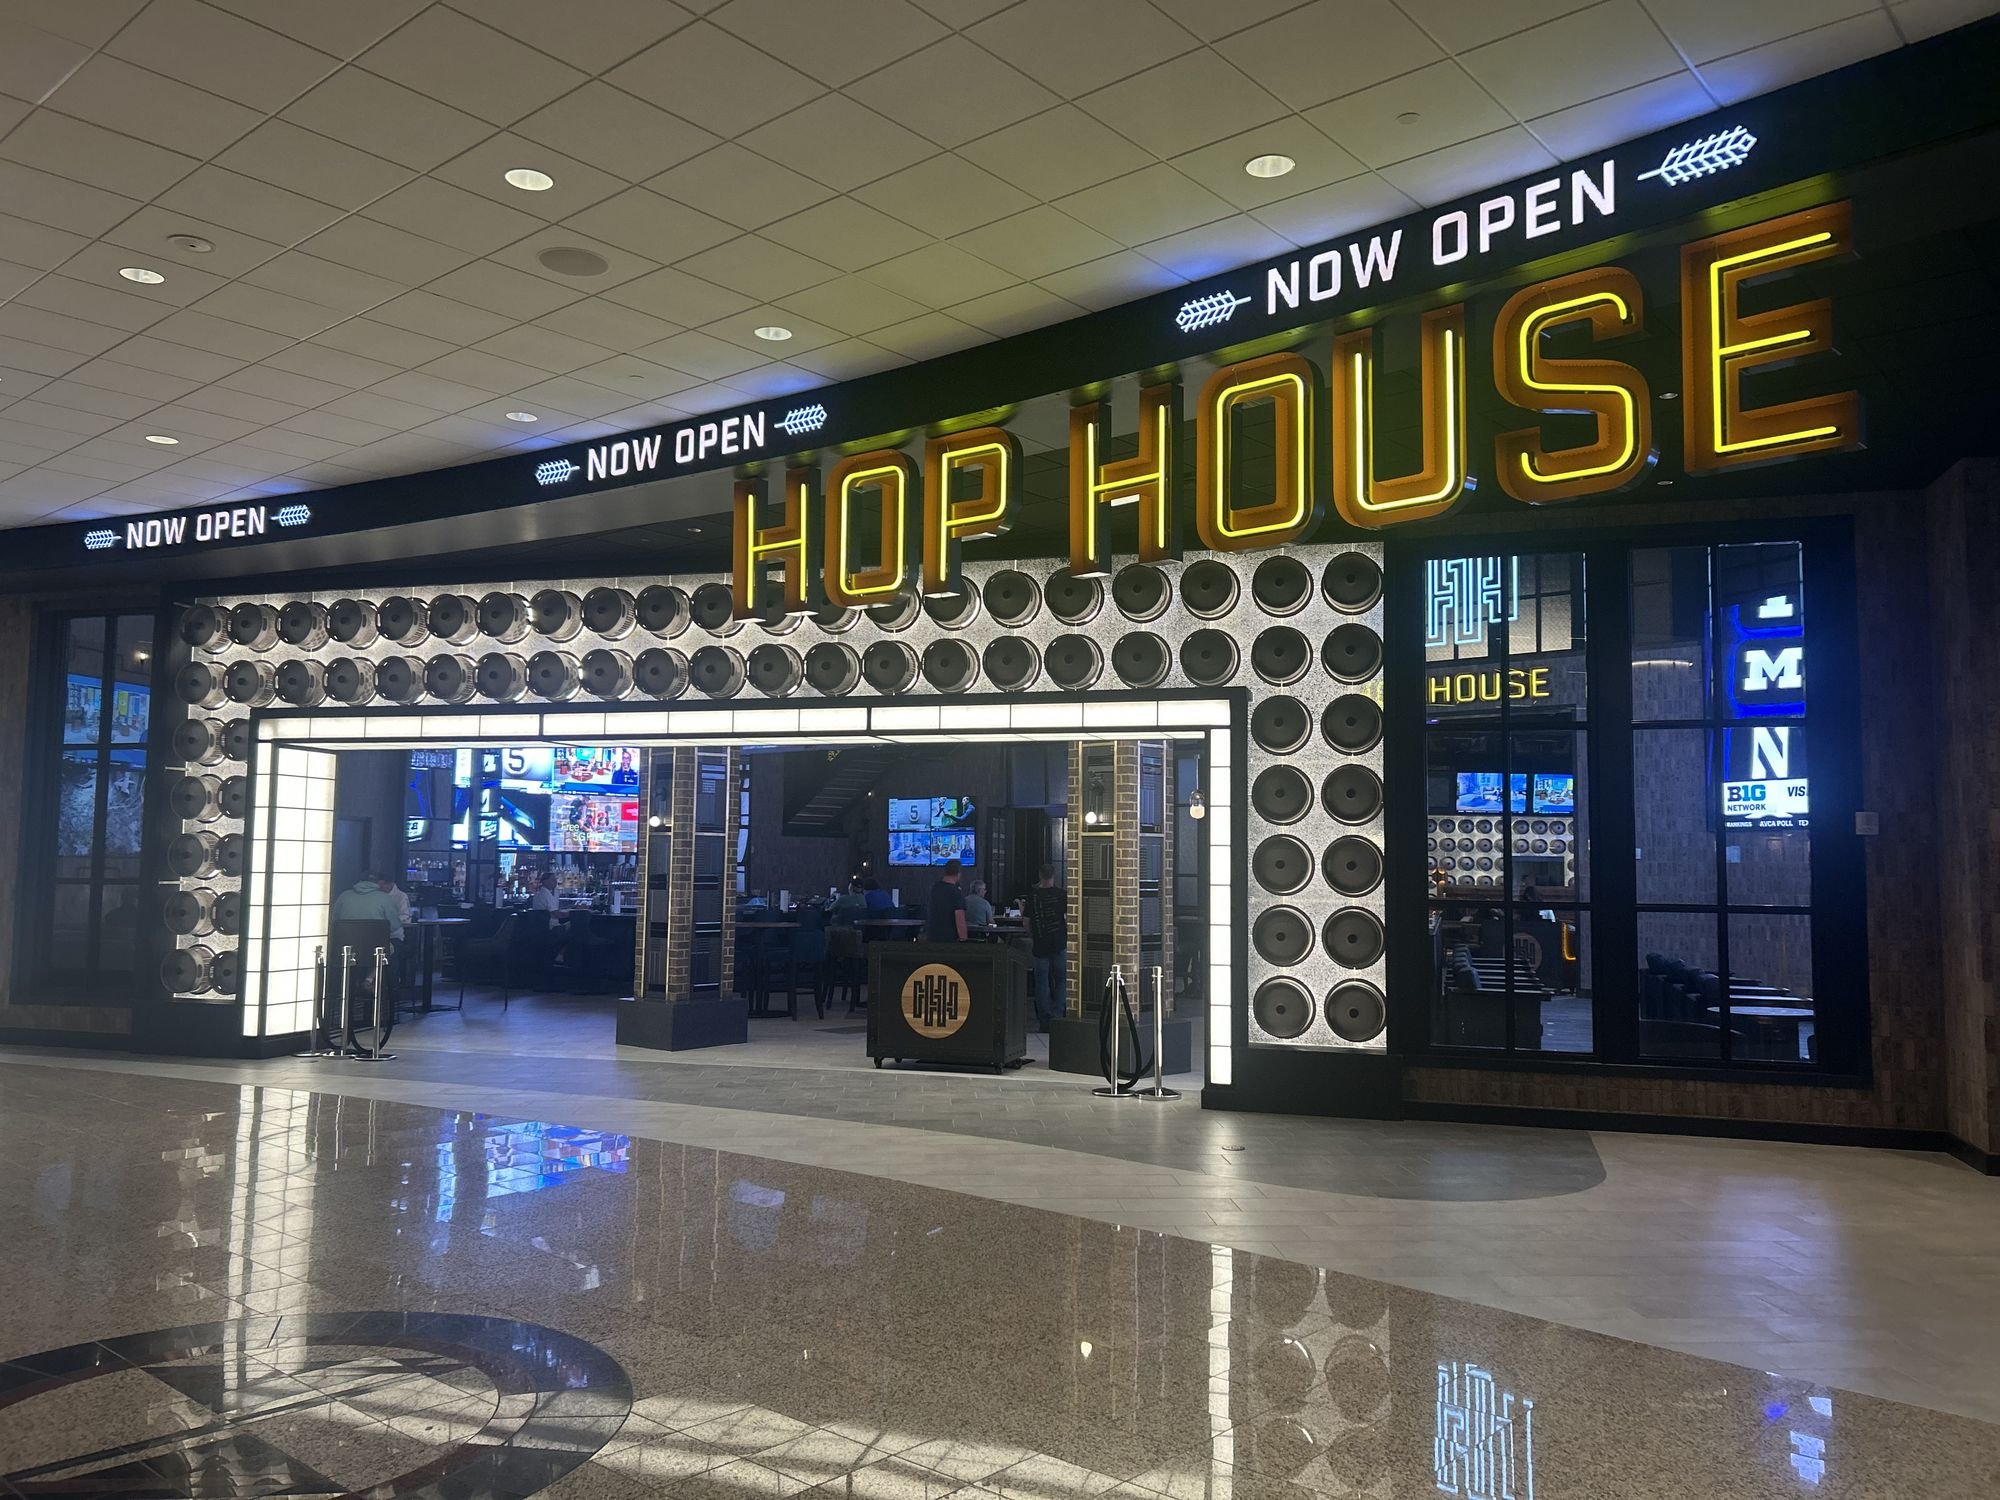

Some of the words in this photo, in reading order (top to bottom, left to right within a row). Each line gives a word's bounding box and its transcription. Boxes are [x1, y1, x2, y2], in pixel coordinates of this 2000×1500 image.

[1266, 229, 1404, 316] NOW
[1431, 158, 1616, 267] OPEN
[733, 426, 1022, 622] HOP
[1069, 200, 1867, 577] HOUSE
[586, 433, 662, 482] NOW
[674, 410, 766, 465] OPEN
[125, 515, 187, 550] NOW
[195, 505, 266, 542] OPEN
[1429, 667, 1550, 703] HOUSE
[1744, 647, 1803, 691] M
[508, 747, 525, 772] 5
[1751, 727, 1789, 779] N
[560, 822, 580, 832] Free
[910, 804, 919, 820] 5
[1727, 804, 1766, 812] NETWORK
